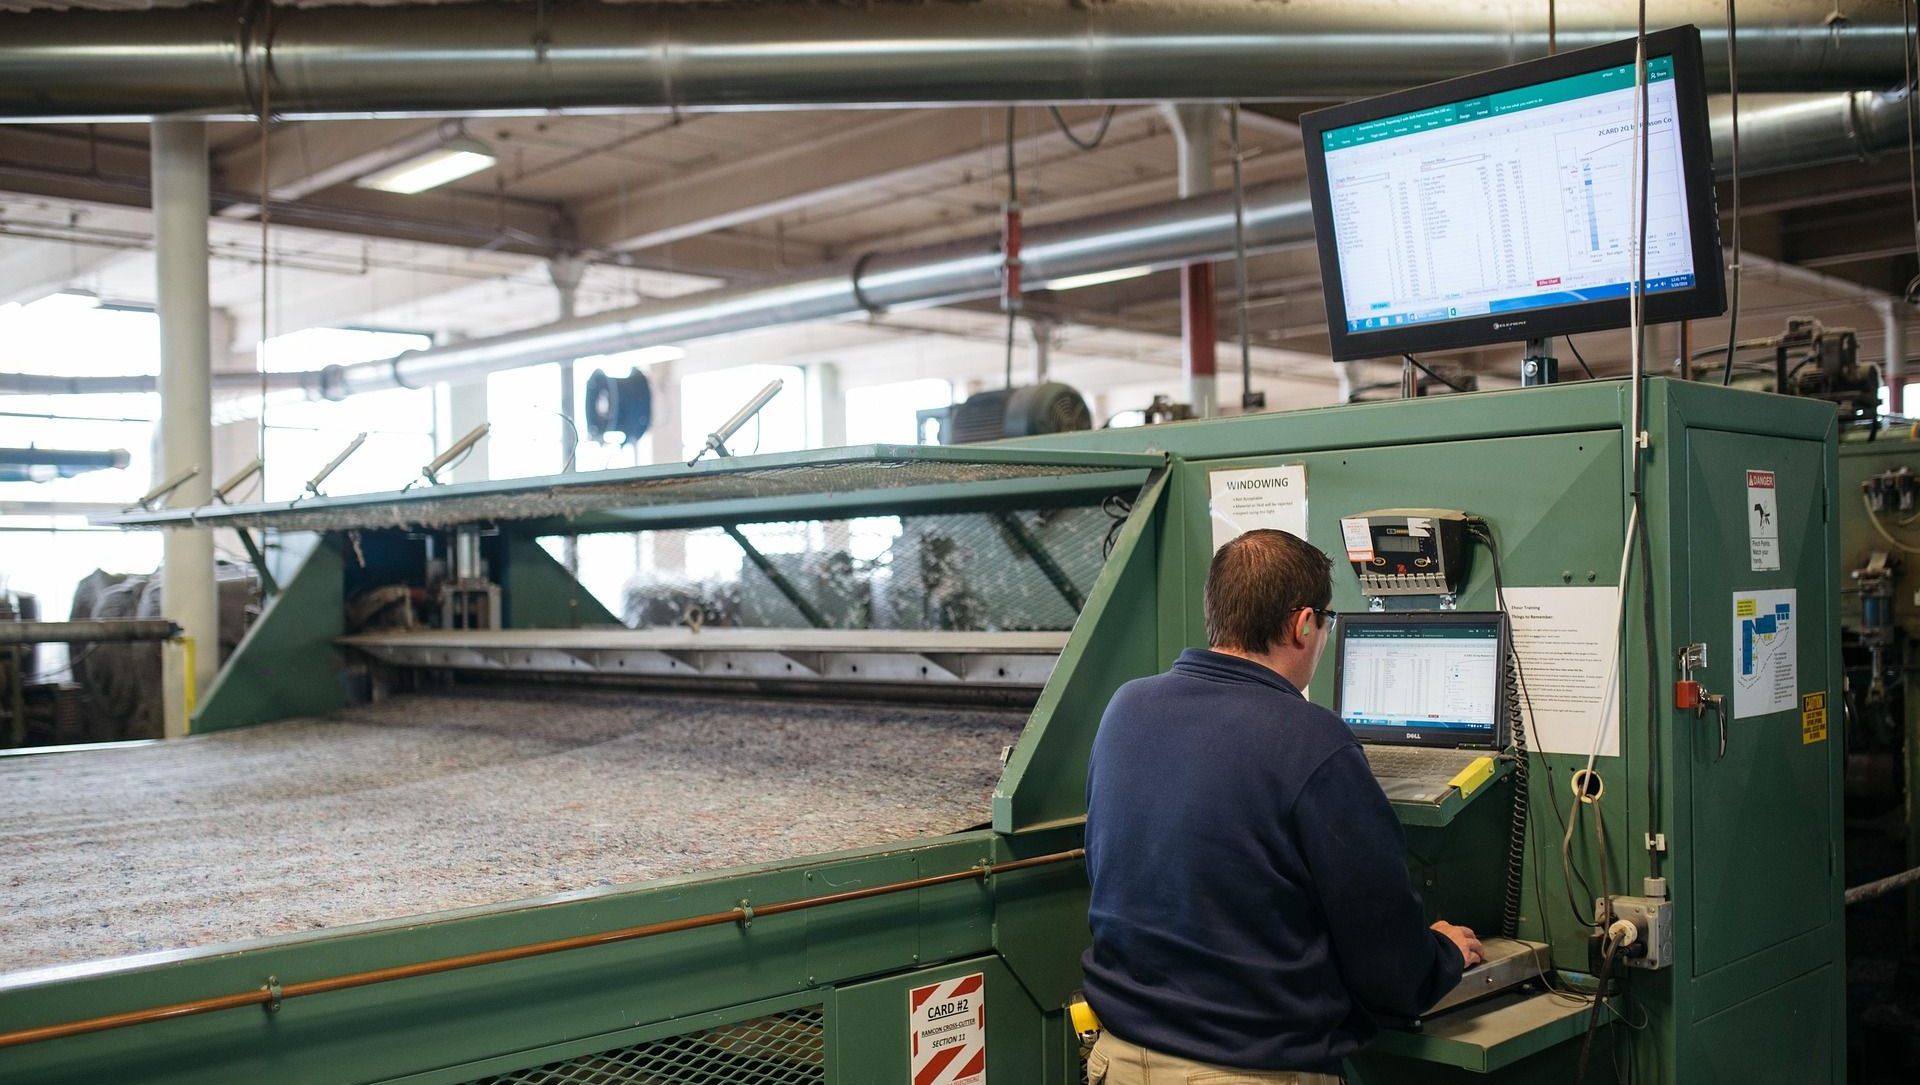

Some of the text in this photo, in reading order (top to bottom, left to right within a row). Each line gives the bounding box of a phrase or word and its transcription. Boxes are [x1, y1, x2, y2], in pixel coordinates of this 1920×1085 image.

[1598, 125, 1619, 136] 2CARD
[1226, 477, 1289, 490] WINDOWING
[1753, 475, 1774, 486] DANGER
[1406, 732, 1421, 740] DELL
[928, 999, 969, 1019] CARD #2
[921, 1018, 976, 1038] RAMCON CROSS-CUTTER
[932, 1033, 966, 1049] SECTION 11
